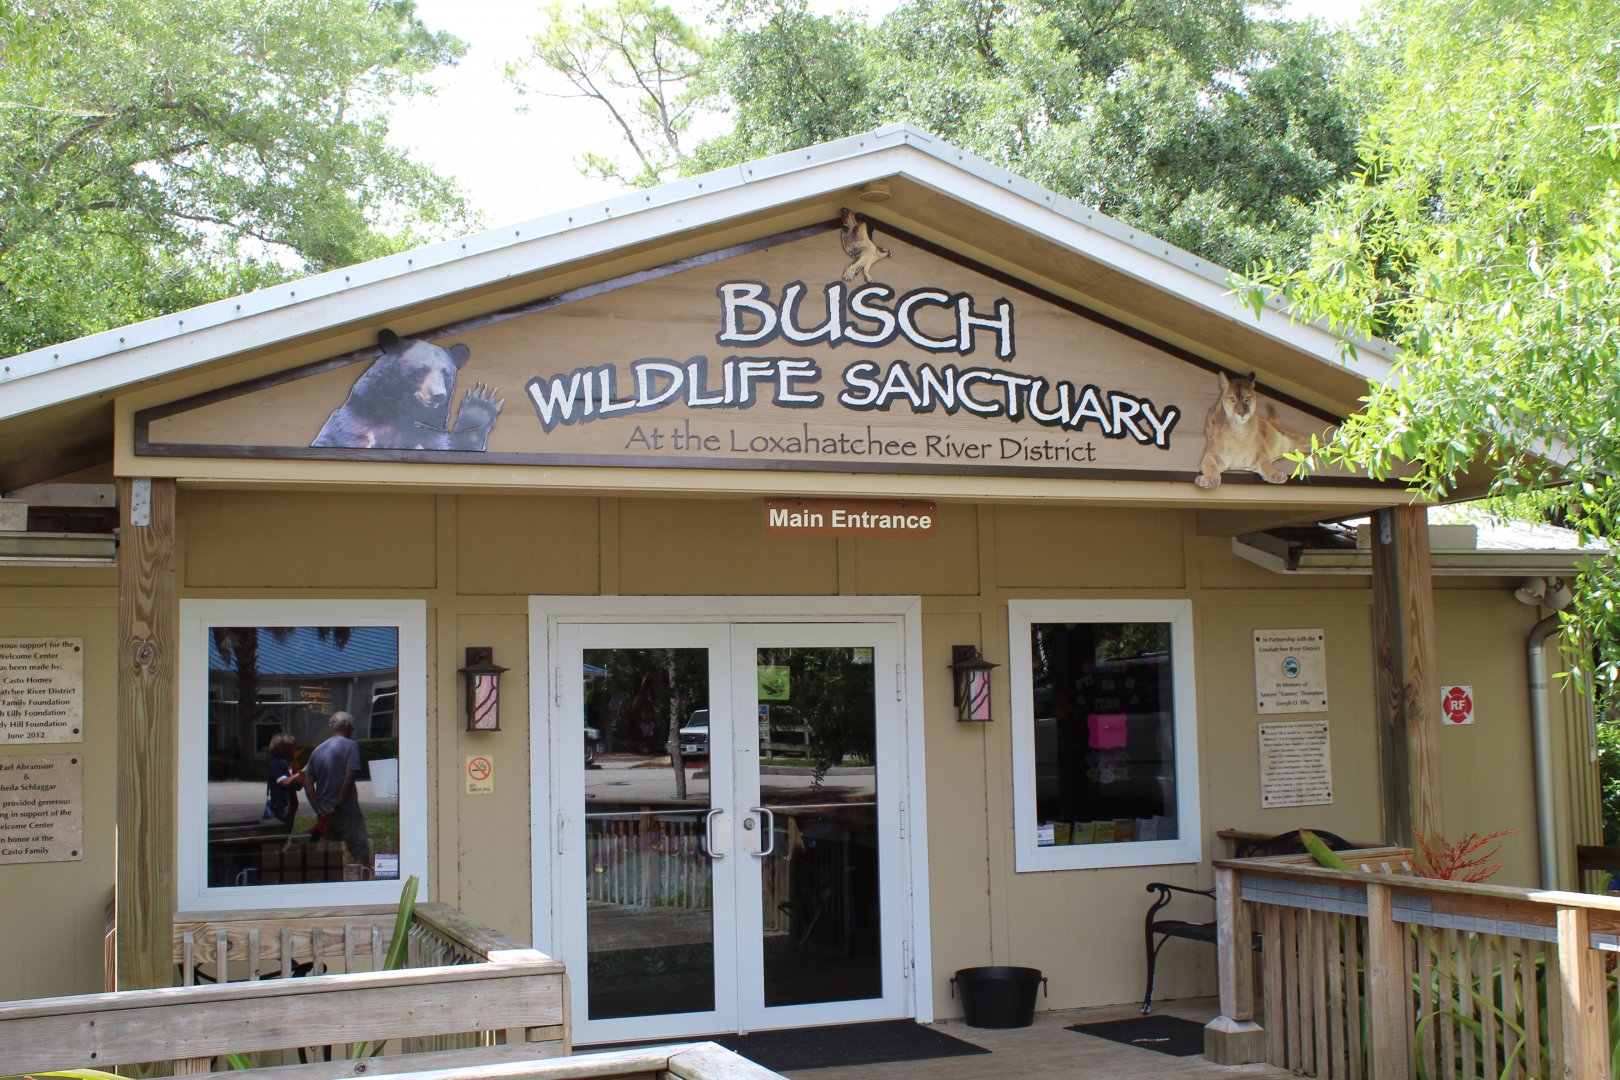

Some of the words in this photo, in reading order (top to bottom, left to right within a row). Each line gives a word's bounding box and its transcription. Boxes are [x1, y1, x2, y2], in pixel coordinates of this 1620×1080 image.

[718, 281, 1013, 359] BUSCH
[527, 357, 822, 430] WILDLIFE
[838, 361, 1178, 448] SANCTUARY
[624, 425, 664, 450] At
[670, 419, 721, 451] the
[730, 422, 917, 457] Loxahatchee
[925, 435, 993, 460] River
[999, 437, 1097, 462] District
[768, 508, 824, 528] Main
[831, 509, 932, 529] Entrance
[20, 642, 47, 651] support
[29, 663, 50, 671] made
[51, 663, 63, 672] by:
[26, 676, 52, 684] Homes
[2, 699, 26, 707] Family
[28, 698, 70, 706] Foundation
[1450, 699, 1466, 711] RF
[7, 710, 22, 718] Lilly
[24, 709, 66, 717] Foundation
[26, 720, 67, 728] Foundation
[7, 732, 25, 740] June
[16, 763, 54, 771] Abramson
[20, 783, 57, 792] Schlaggar
[2, 799, 36, 808] provided
[38, 799, 71, 807] generous
[20, 810, 49, 819] support
[25, 847, 50, 855] Family
